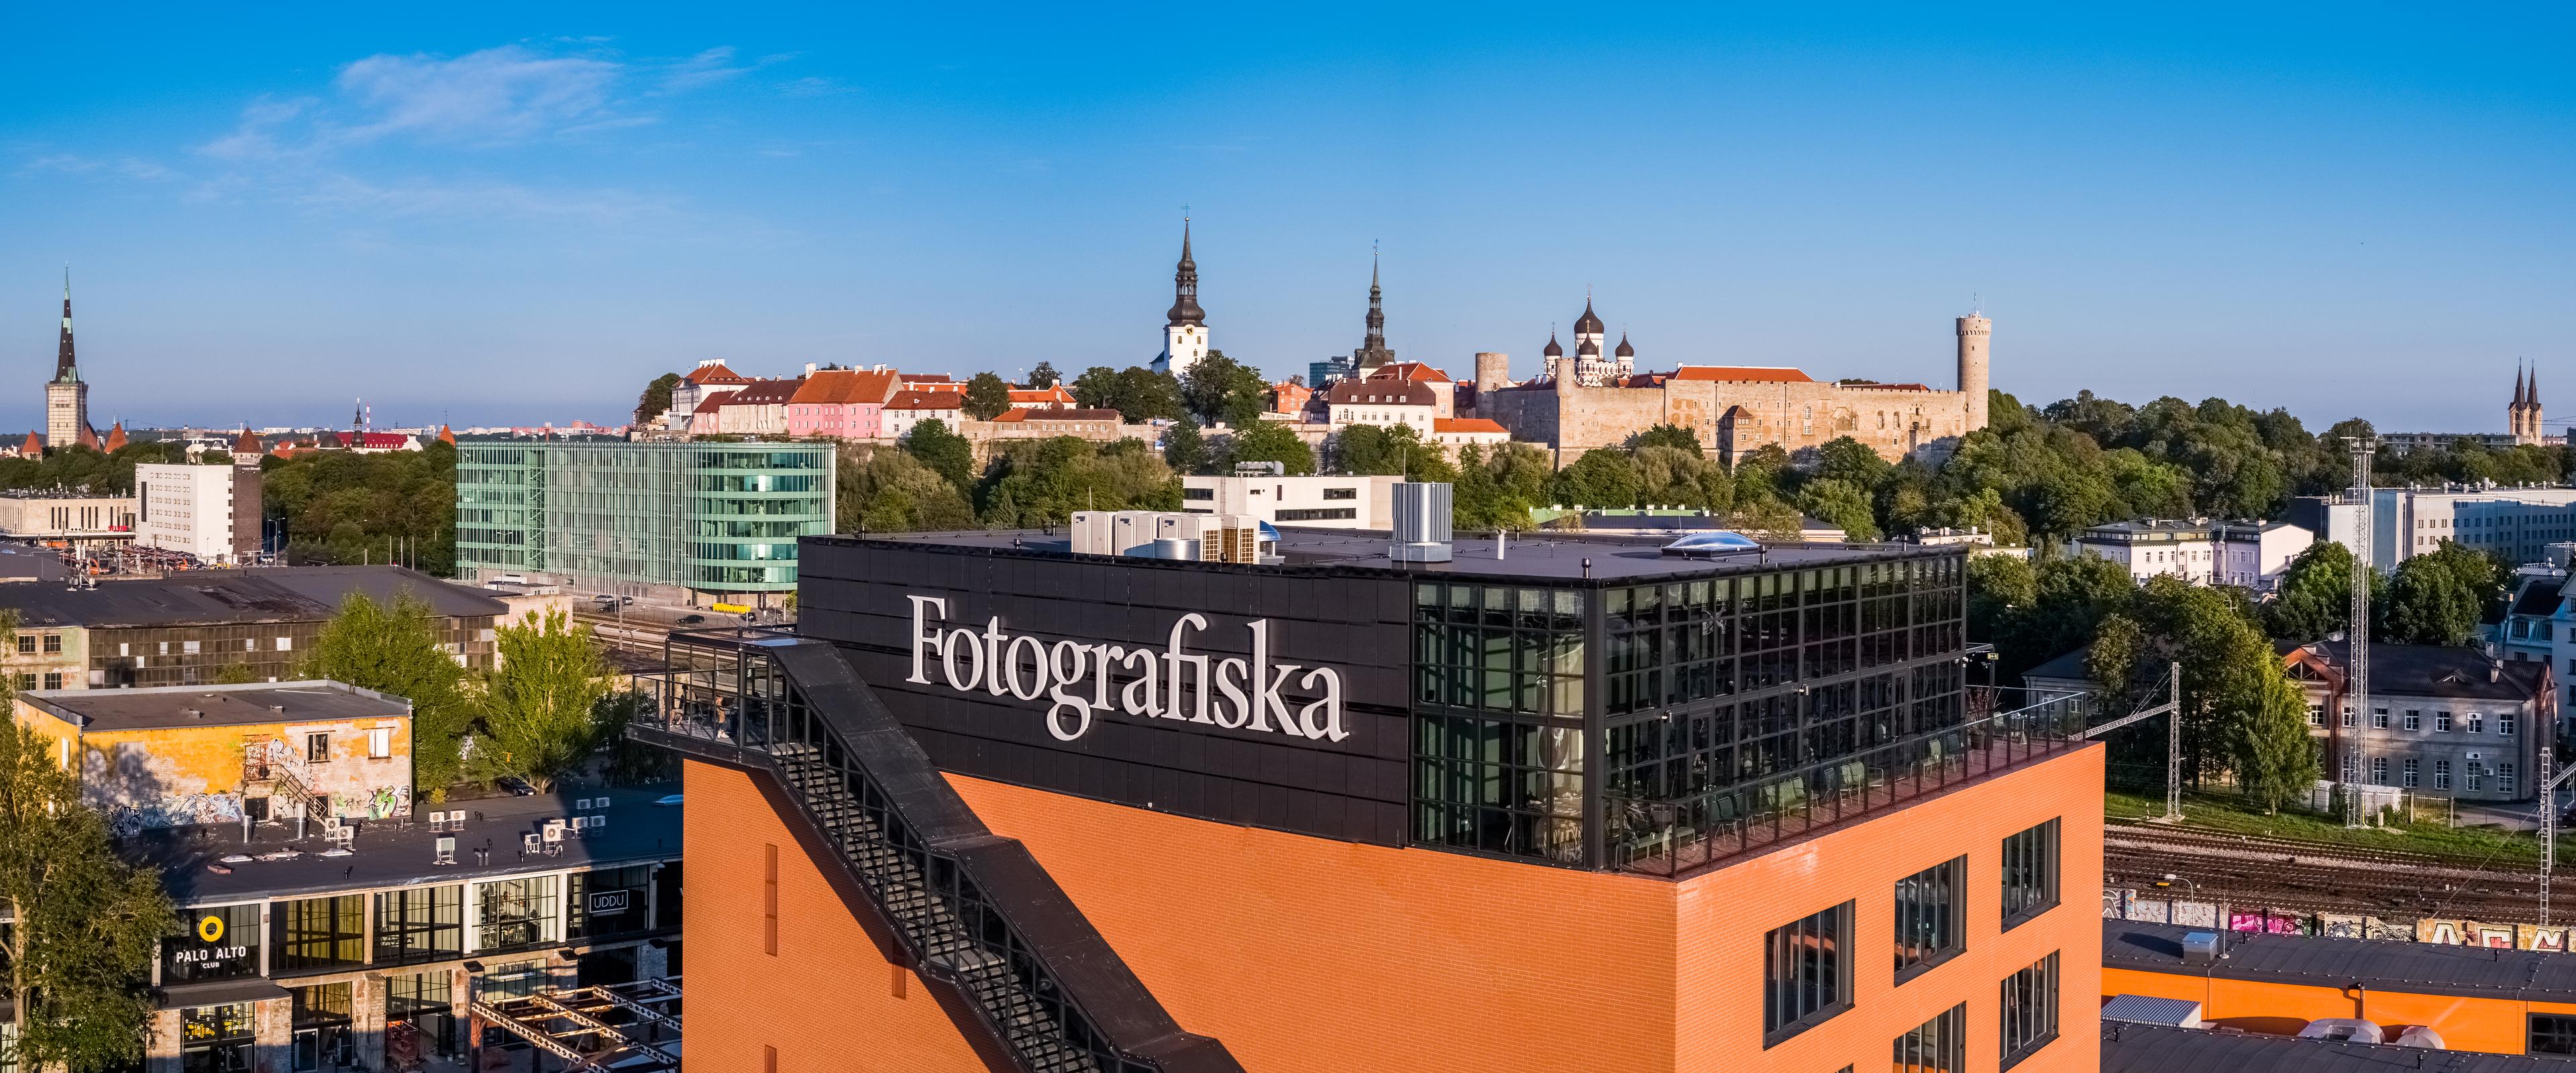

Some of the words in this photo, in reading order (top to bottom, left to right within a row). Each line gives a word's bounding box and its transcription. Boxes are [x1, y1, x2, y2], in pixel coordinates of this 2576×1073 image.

[906, 595, 1350, 742] Fotografiska
[594, 894, 624, 908] UDDU
[176, 950, 208, 963] PALO
[215, 946, 246, 960] ALTO
